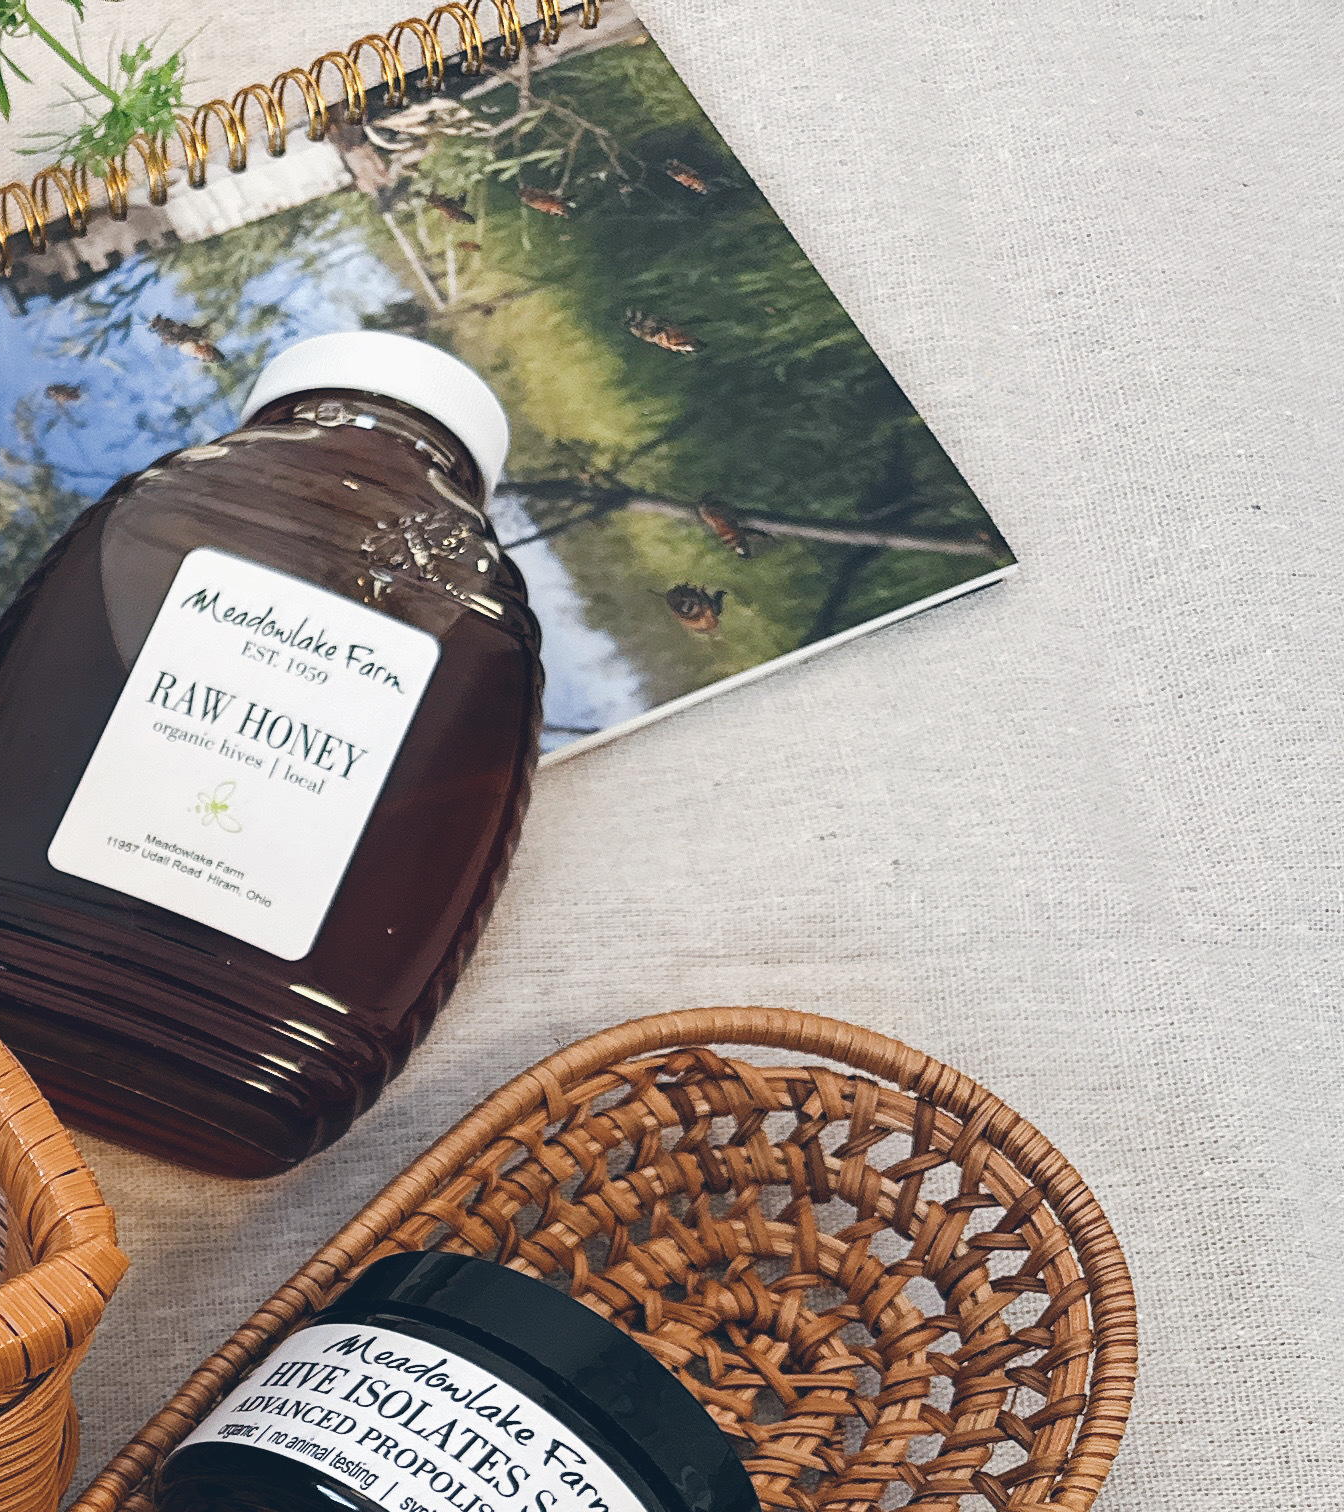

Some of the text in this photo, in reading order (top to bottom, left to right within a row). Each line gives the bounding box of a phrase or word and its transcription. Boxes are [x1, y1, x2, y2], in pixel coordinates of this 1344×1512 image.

[180, 587, 403, 694] Meadowlake Farm
[241, 640, 329, 685] EST. 1959
[147, 670, 368, 779] RAW HONEY
[152, 721, 326, 795] organic hives local
[145, 833, 245, 880] Meadowlake Farm
[171, 858, 203, 879] Road
[245, 889, 272, 908] Ohio
[229, 1395, 358, 1435] ADVANCED
[321, 1333, 536, 1447] Meadowlake
[216, 1423, 258, 1439] organic
[266, 1430, 289, 1446] no
[284, 1435, 337, 1462] animal
[328, 1450, 380, 1491] testing
[259, 1360, 351, 1395] HIVE
[339, 1373, 531, 1498] ISOLATES
